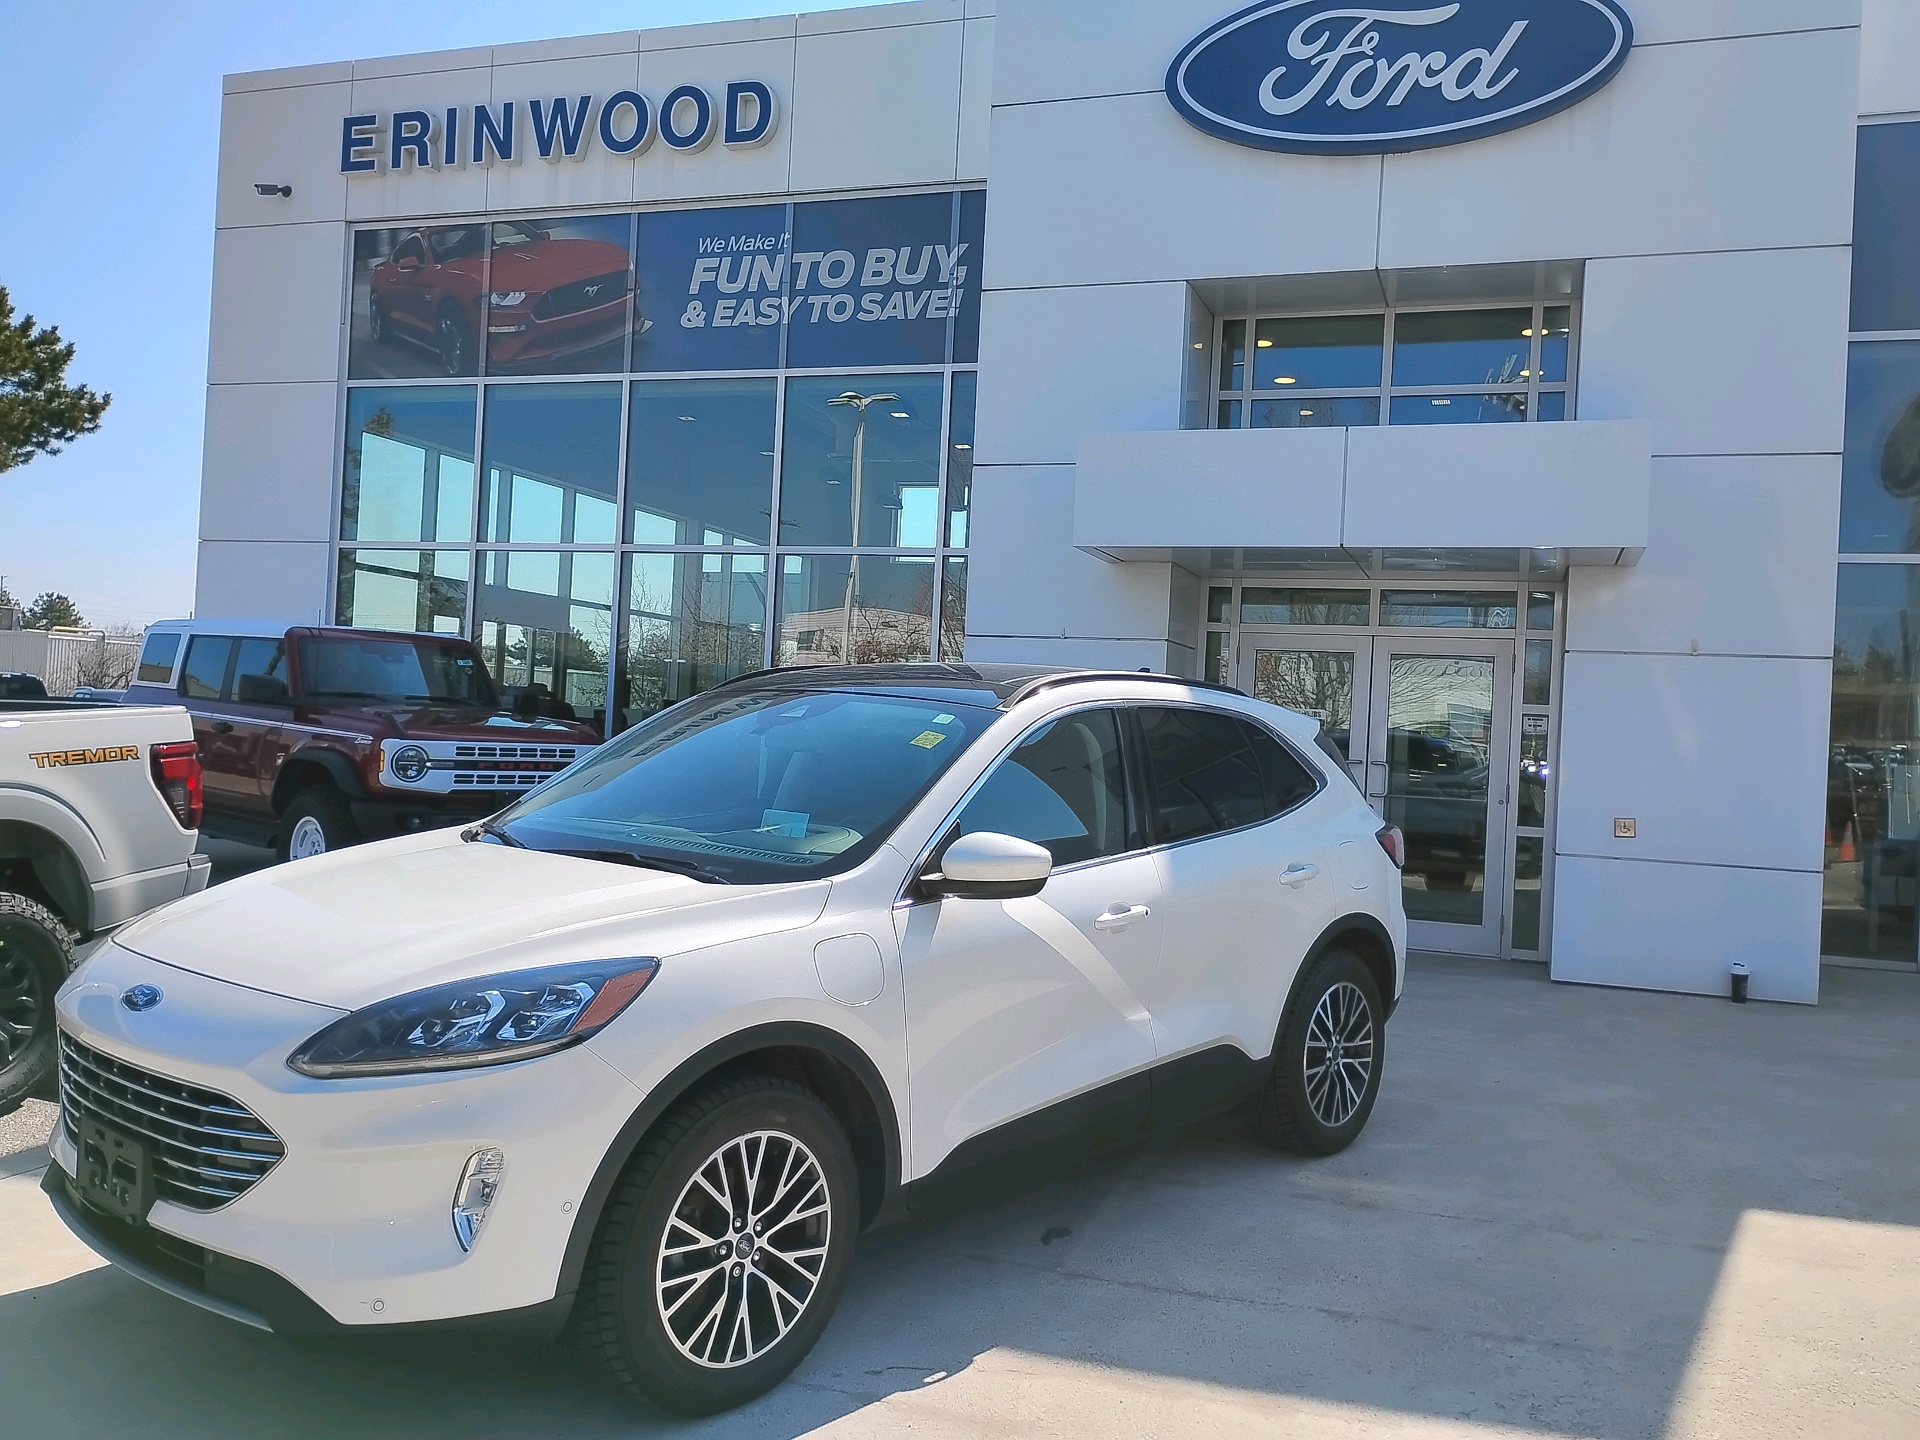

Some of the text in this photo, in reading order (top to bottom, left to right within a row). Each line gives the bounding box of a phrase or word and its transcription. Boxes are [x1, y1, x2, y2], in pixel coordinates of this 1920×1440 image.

[1258, 2, 1530, 116] Ford
[341, 79, 775, 174] ERINWOOD
[699, 232, 791, 254] We Make It
[689, 243, 970, 294] FUN TO BUY,
[680, 289, 964, 328] & EASY TO SAVE!
[28, 745, 140, 768] TREMOR
